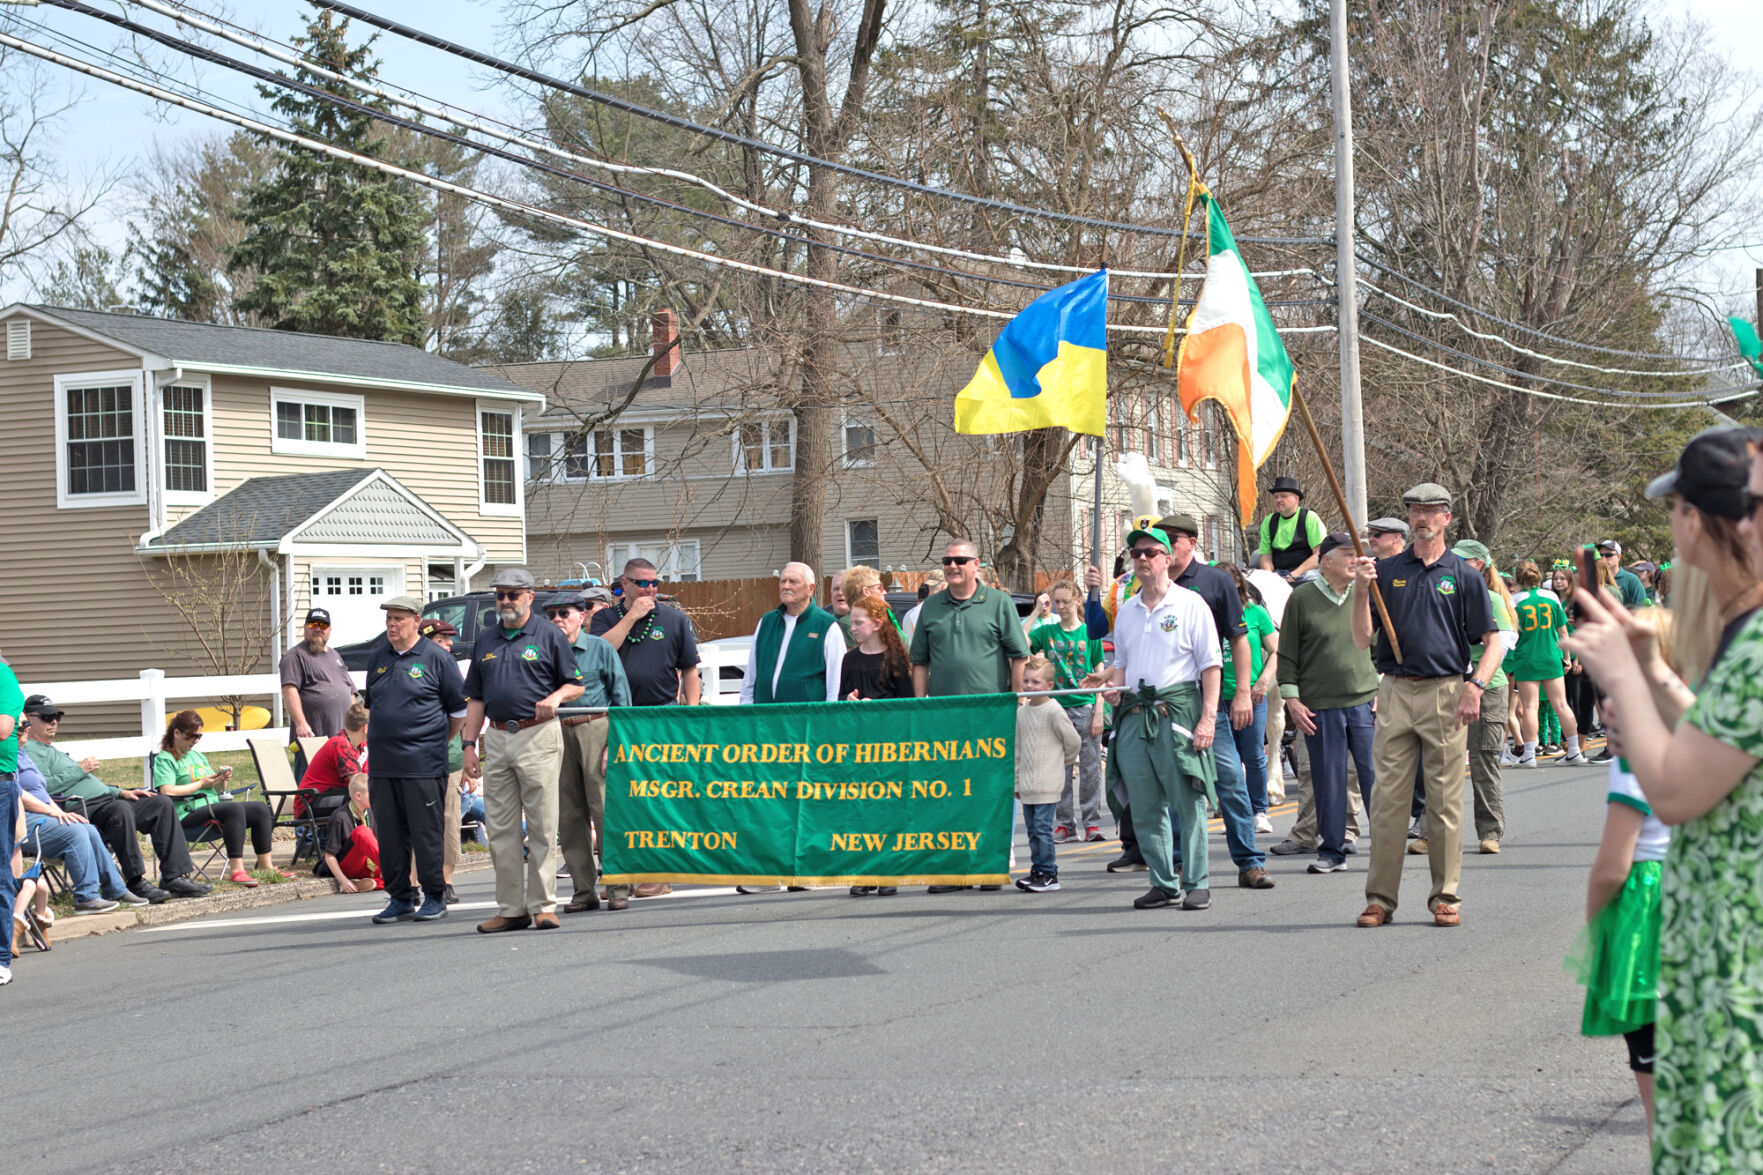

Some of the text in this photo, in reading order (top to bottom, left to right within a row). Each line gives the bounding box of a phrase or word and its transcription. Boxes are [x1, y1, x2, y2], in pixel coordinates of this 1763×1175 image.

[1522, 603, 1552, 631] 33
[614, 737, 1007, 764] ANCIENT ORDER OF HIBERNIANS
[629, 778, 972, 800] MSGR. CREAN DIVISION NO. 1
[625, 831, 981, 852] TRENTON NEW JERSEY
